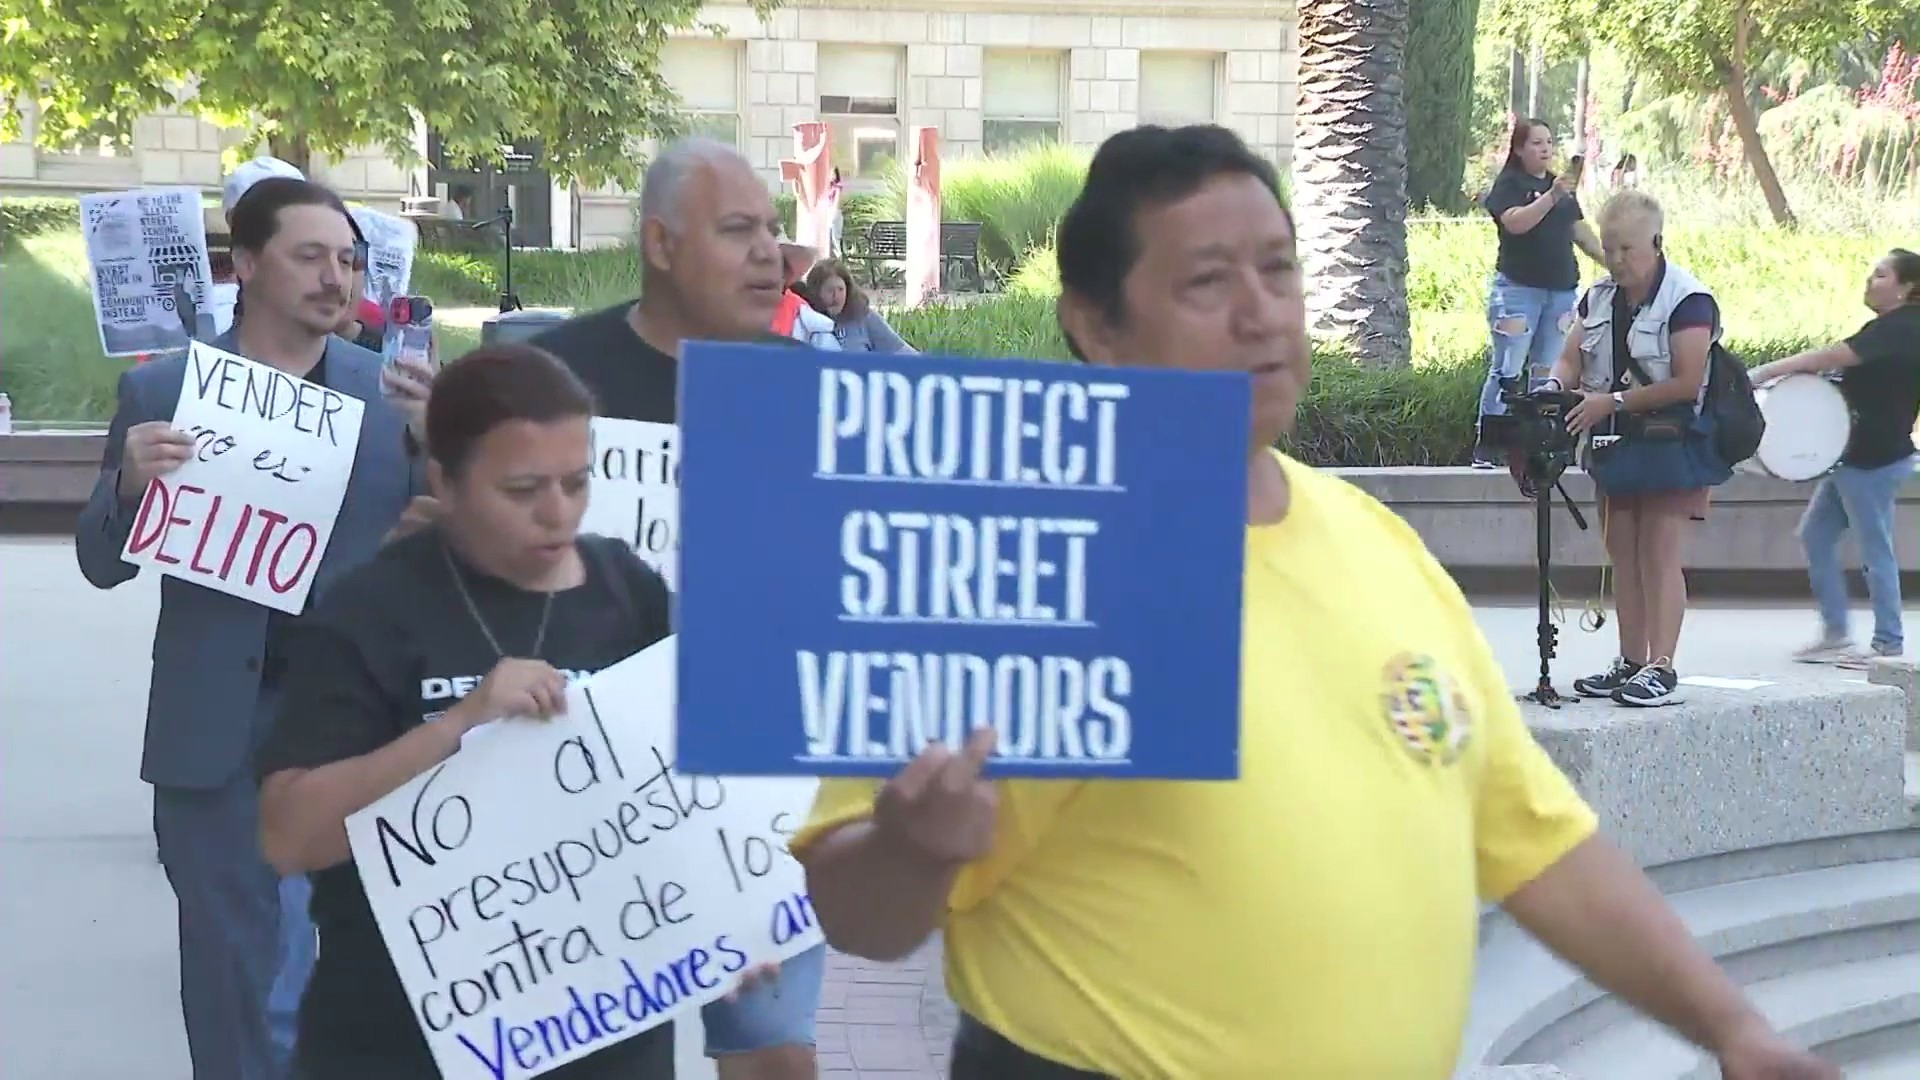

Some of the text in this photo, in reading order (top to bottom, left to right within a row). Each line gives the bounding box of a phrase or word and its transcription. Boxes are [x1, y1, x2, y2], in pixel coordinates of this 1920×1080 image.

[193, 347, 344, 447] VENDER
[816, 366, 1131, 486] PROTECT
[128, 477, 318, 594] DELITO
[839, 509, 1100, 622] STREET
[554, 686, 625, 795] al
[796, 649, 1132, 760] VENDORS
[408, 746, 727, 980] presupuesto
[420, 920, 605, 1033] contra
[619, 874, 694, 943] de
[456, 934, 748, 1080] Vendedores
